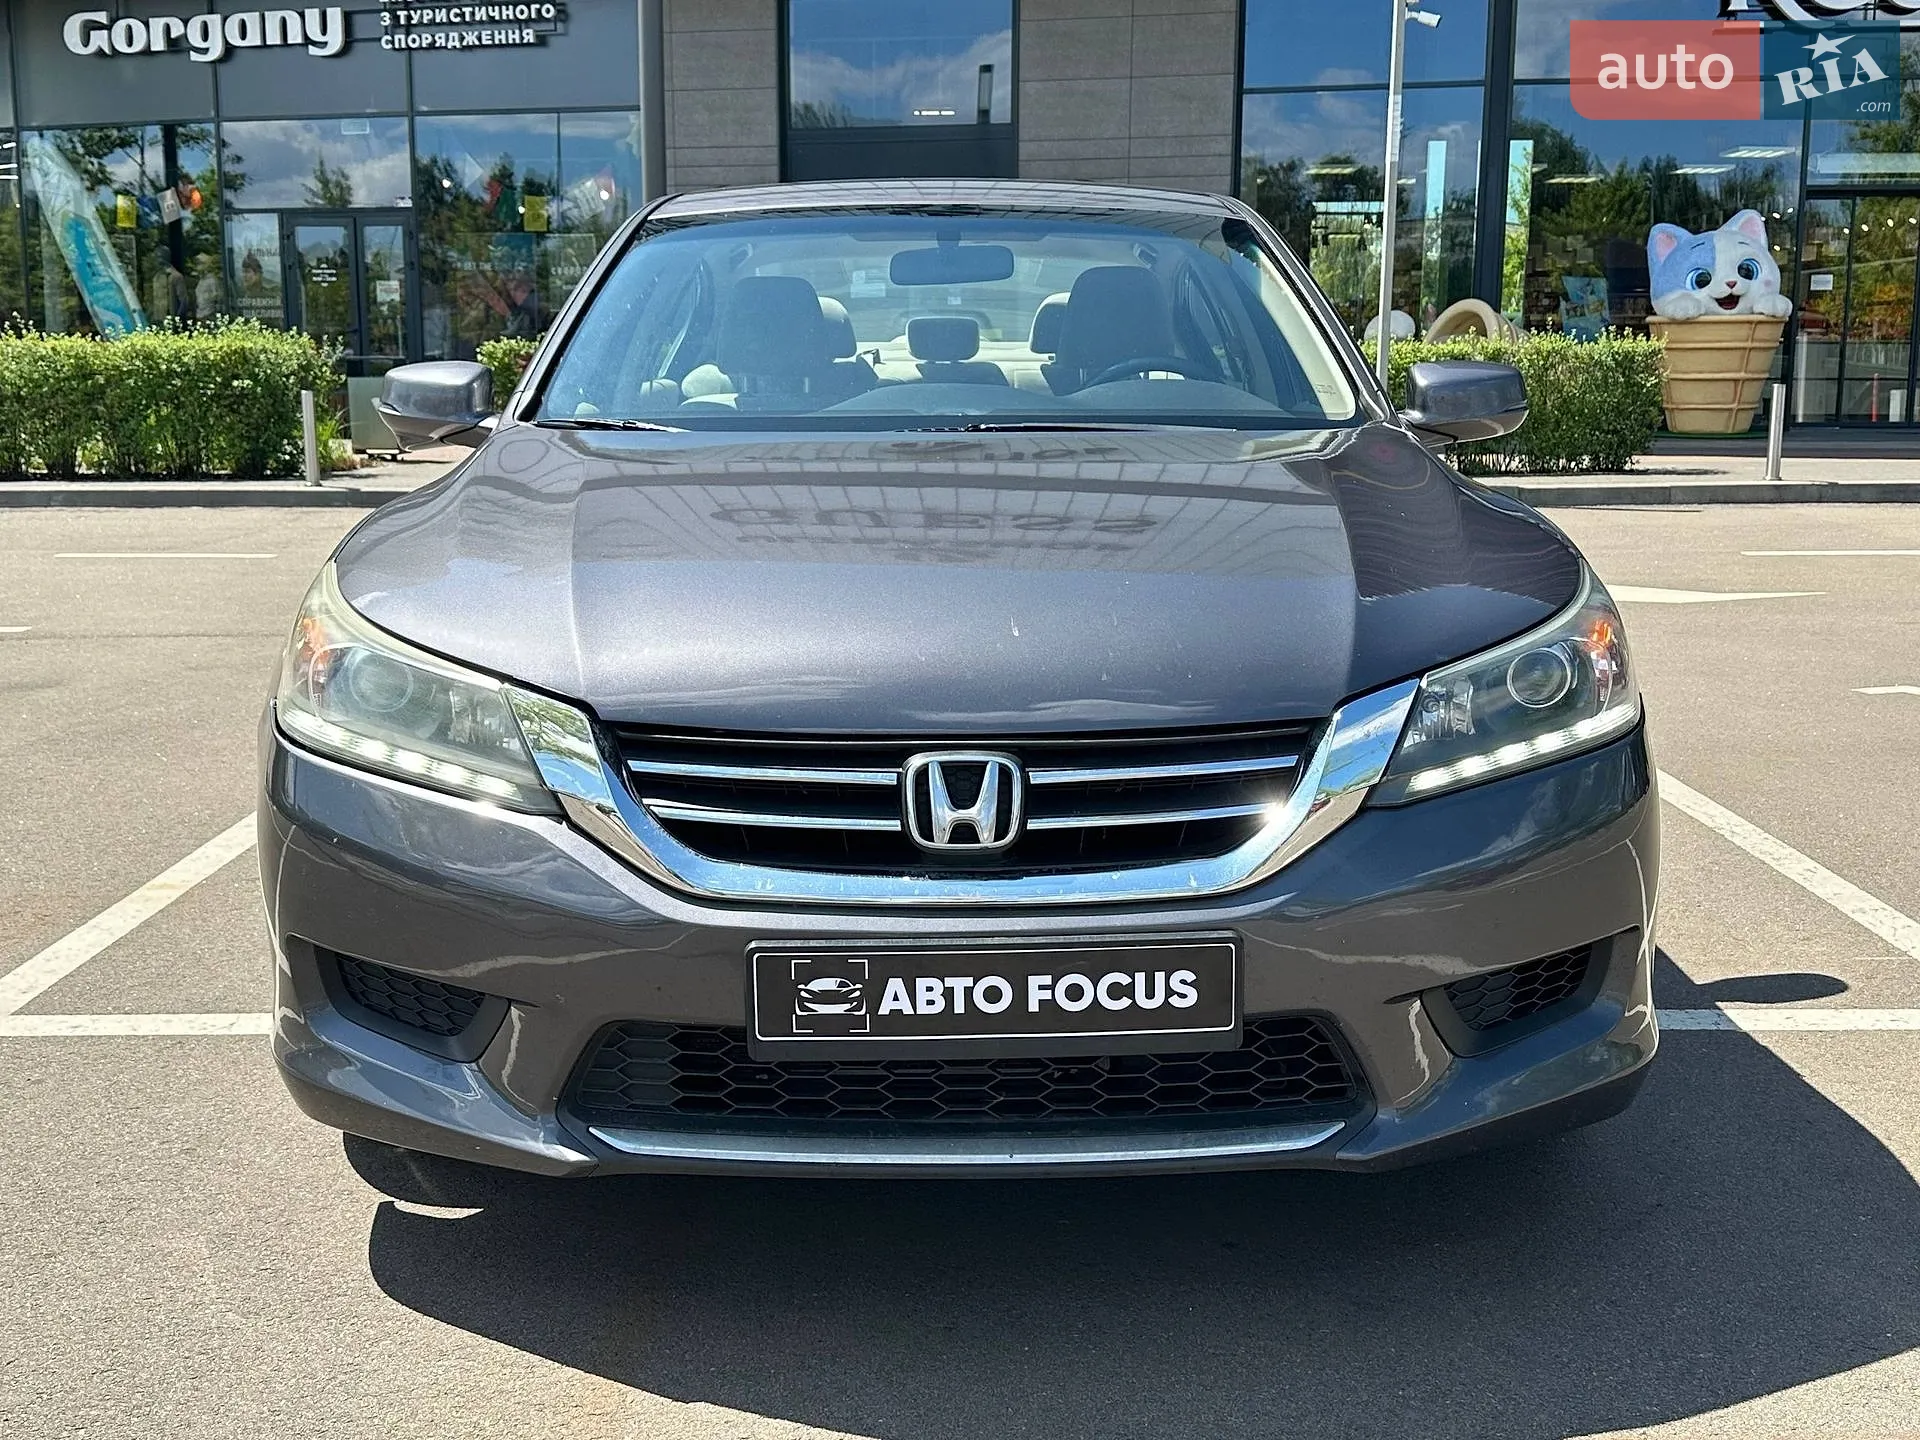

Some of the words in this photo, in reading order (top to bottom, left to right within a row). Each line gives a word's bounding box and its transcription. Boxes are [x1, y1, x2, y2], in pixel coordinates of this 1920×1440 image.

[380, 12, 391, 26] З
[397, 4, 556, 25] ТУРИСТИЧНОГО
[62, 7, 345, 62] Gorgany
[380, 29, 536, 49] СПОРЯДЖЕННЯ
[877, 976, 1013, 1016] АВТО
[1027, 970, 1198, 1013] FOCUS
